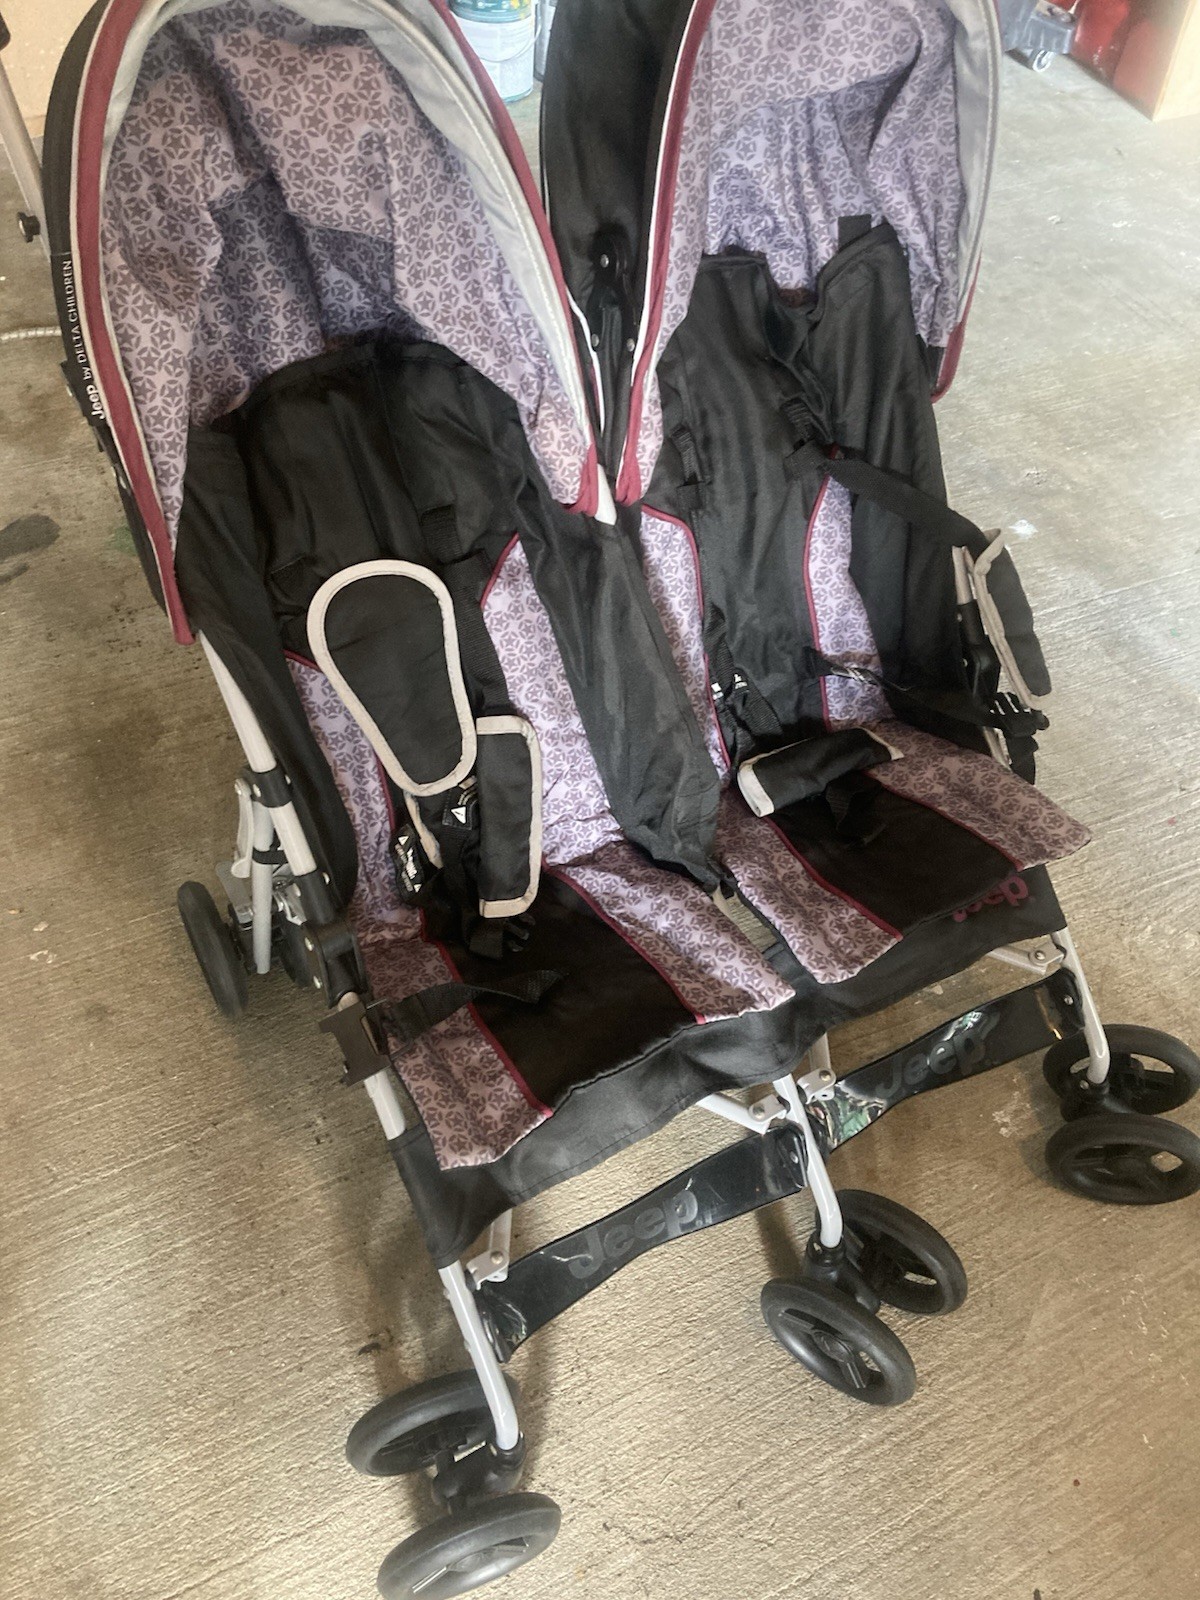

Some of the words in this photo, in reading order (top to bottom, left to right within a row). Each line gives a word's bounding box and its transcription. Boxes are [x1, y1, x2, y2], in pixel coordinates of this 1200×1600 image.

[62, 260, 78, 322] CHILDREN
[72, 325, 87, 363] DELTA
[82, 367, 92, 380] by
[86, 384, 105, 419] Jeep
[875, 1030, 987, 1099] Jeep
[568, 1189, 698, 1279] Jeep
